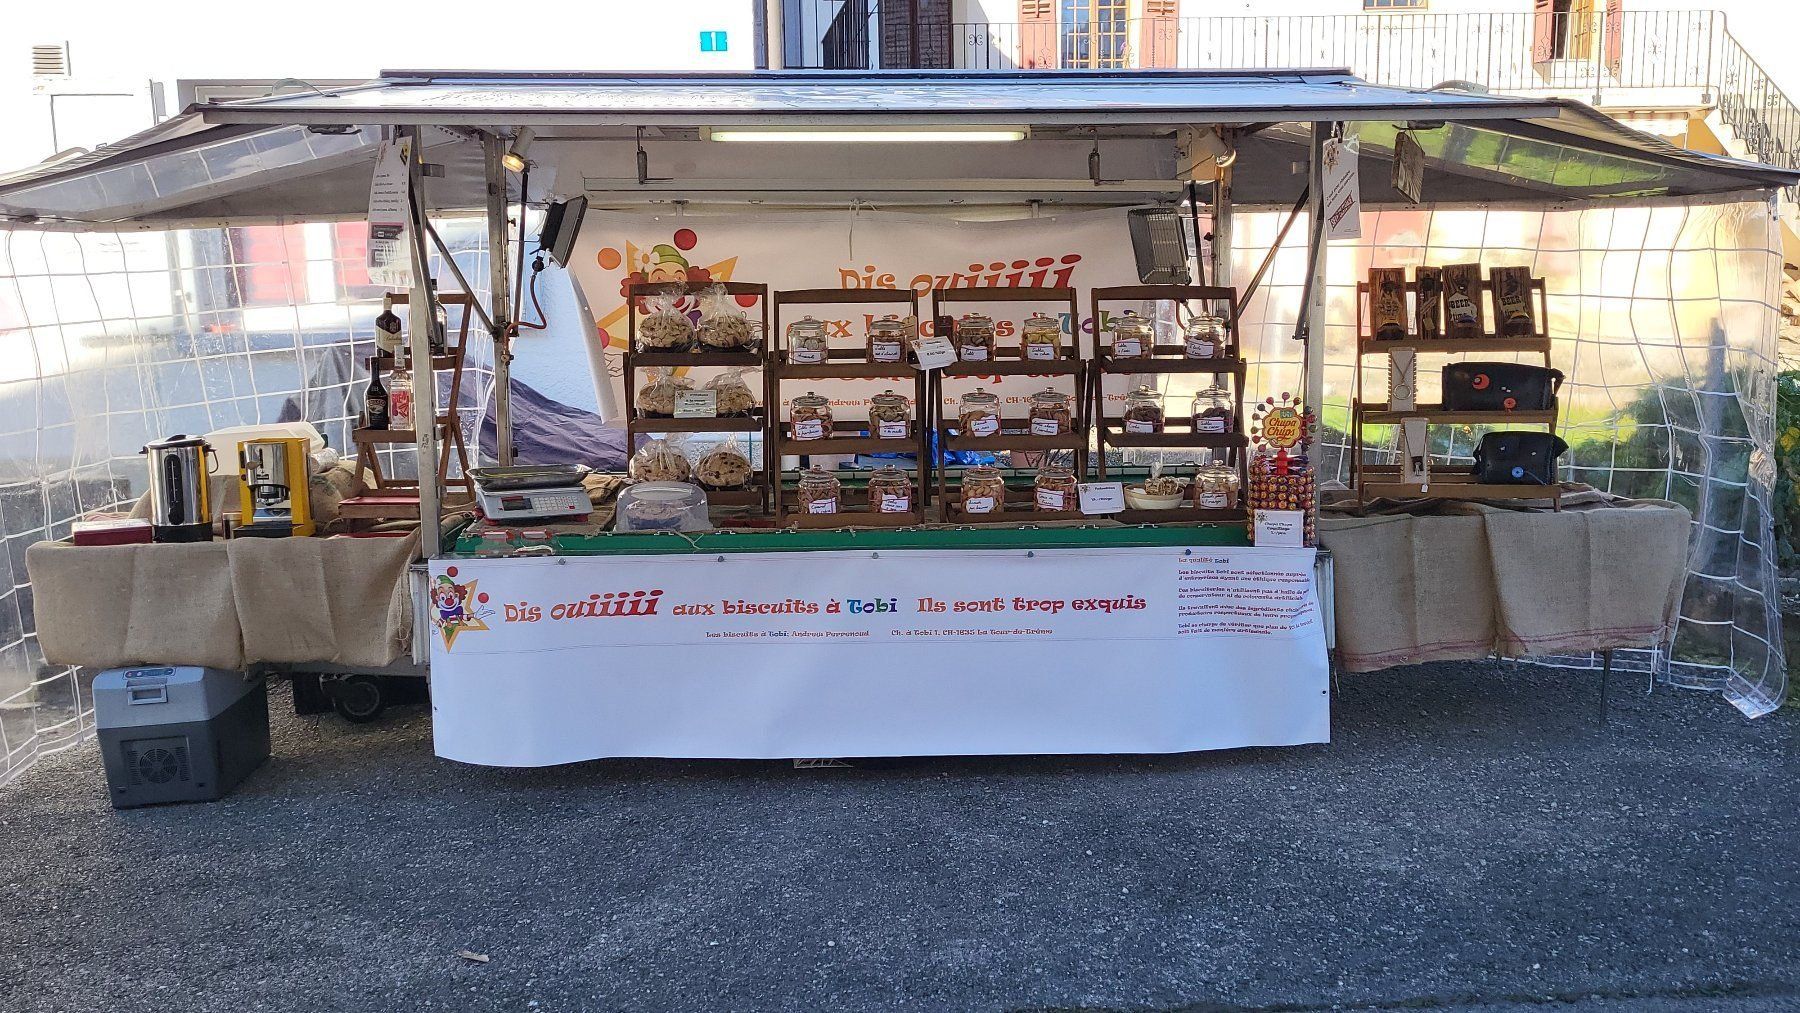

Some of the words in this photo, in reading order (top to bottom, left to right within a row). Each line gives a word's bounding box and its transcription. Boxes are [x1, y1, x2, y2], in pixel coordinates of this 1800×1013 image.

[838, 264, 897, 289] Dis
[1450, 299, 1471, 308] BEER
[1501, 296, 1522, 305] BEER
[1269, 417, 1297, 428] Chupa
[1267, 426, 1295, 437] Chups
[504, 601, 542, 622] Dis
[672, 603, 715, 616] aux
[722, 598, 819, 615] biscuits
[825, 597, 841, 614] à
[847, 597, 898, 615] Tobi
[917, 597, 947, 614] Ils
[953, 597, 1005, 613] sont
[1012, 597, 1065, 616] trop
[1071, 594, 1147, 615] exquis
[723, 630, 759, 638] biscuits
